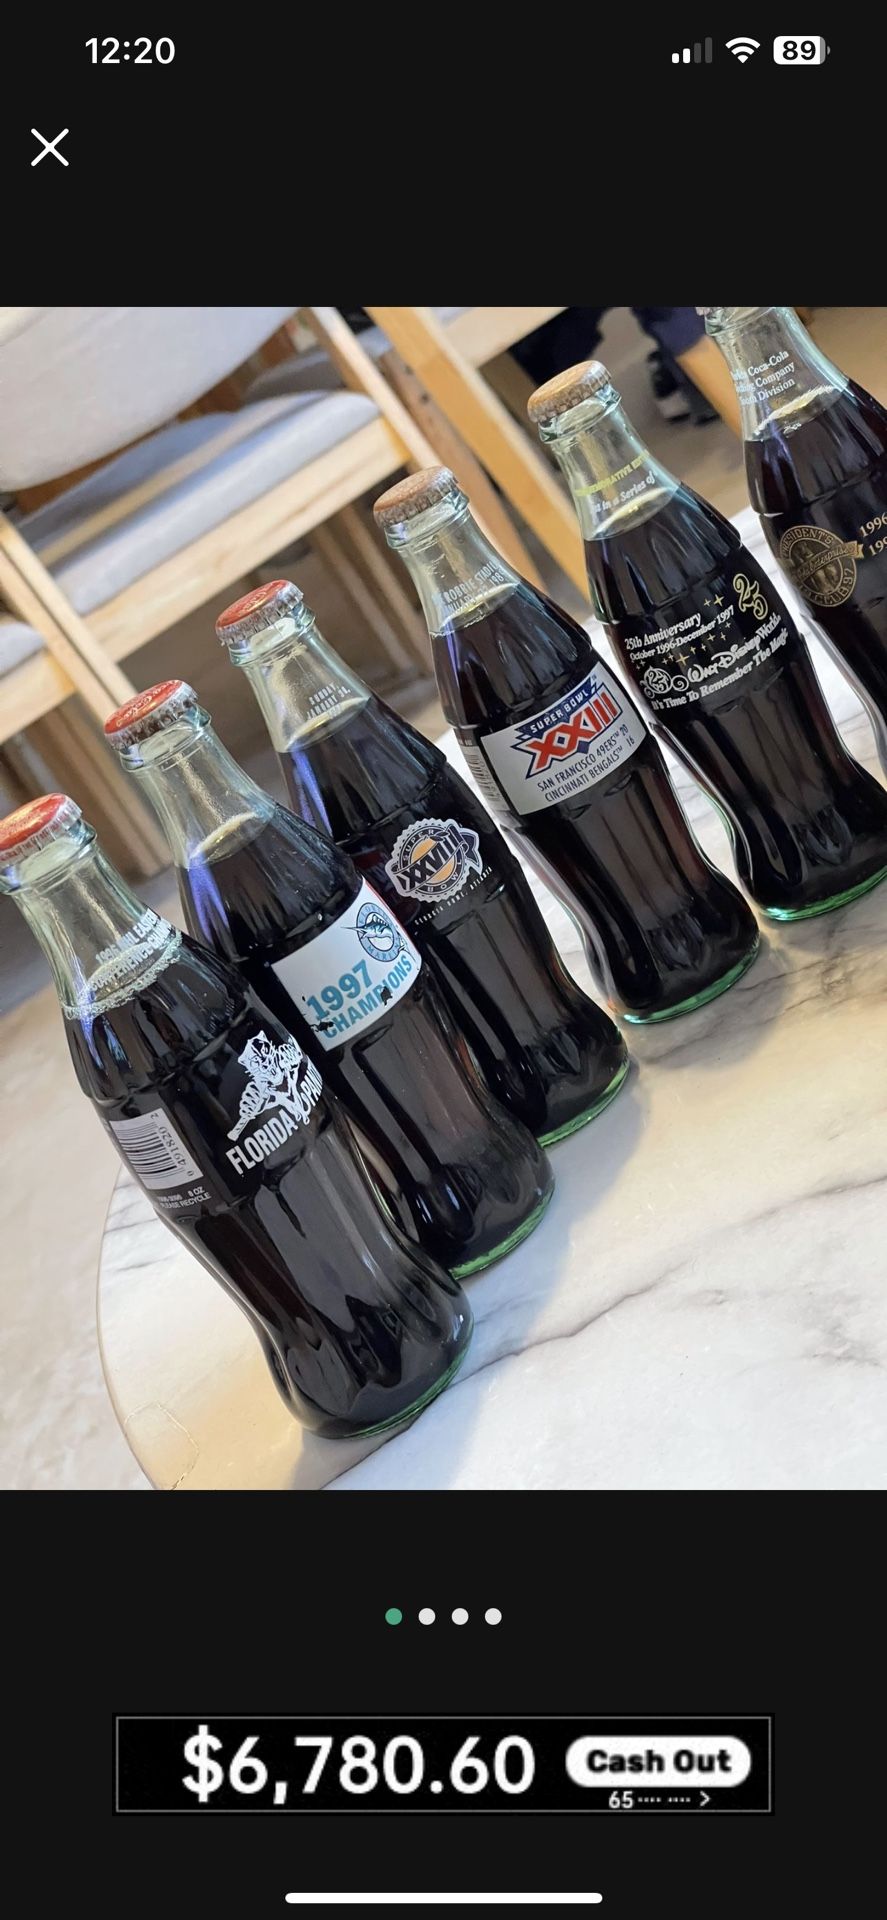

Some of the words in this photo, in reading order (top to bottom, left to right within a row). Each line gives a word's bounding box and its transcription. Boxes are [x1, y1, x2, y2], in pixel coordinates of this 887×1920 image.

[747, 350, 789, 376] Coca-Cola
[755, 361, 795, 387] Company
[757, 378, 796, 401] Division
[620, 480, 646, 502] Series
[716, 604, 735, 626] 1997
[732, 572, 769, 620] 25
[624, 633, 643, 651] 25th
[643, 612, 702, 647] Anniversary
[663, 695, 688, 710] Time
[686, 689, 700, 703] To
[699, 660, 755, 698] Remember
[752, 647, 772, 667] The
[525, 691, 618, 770] XXIII
[529, 709, 565, 734] SUPER
[563, 689, 589, 713] BOWL
[537, 779, 556, 792] SAN
[555, 755, 598, 784] FRANCISCO
[544, 774, 590, 803] CINCINNATI
[306, 959, 373, 1021] 1997
[322, 954, 413, 1039] CHAMPIONS
[225, 1109, 299, 1175] FLORIDA
[180, 1192, 212, 1208] RECYCLE
